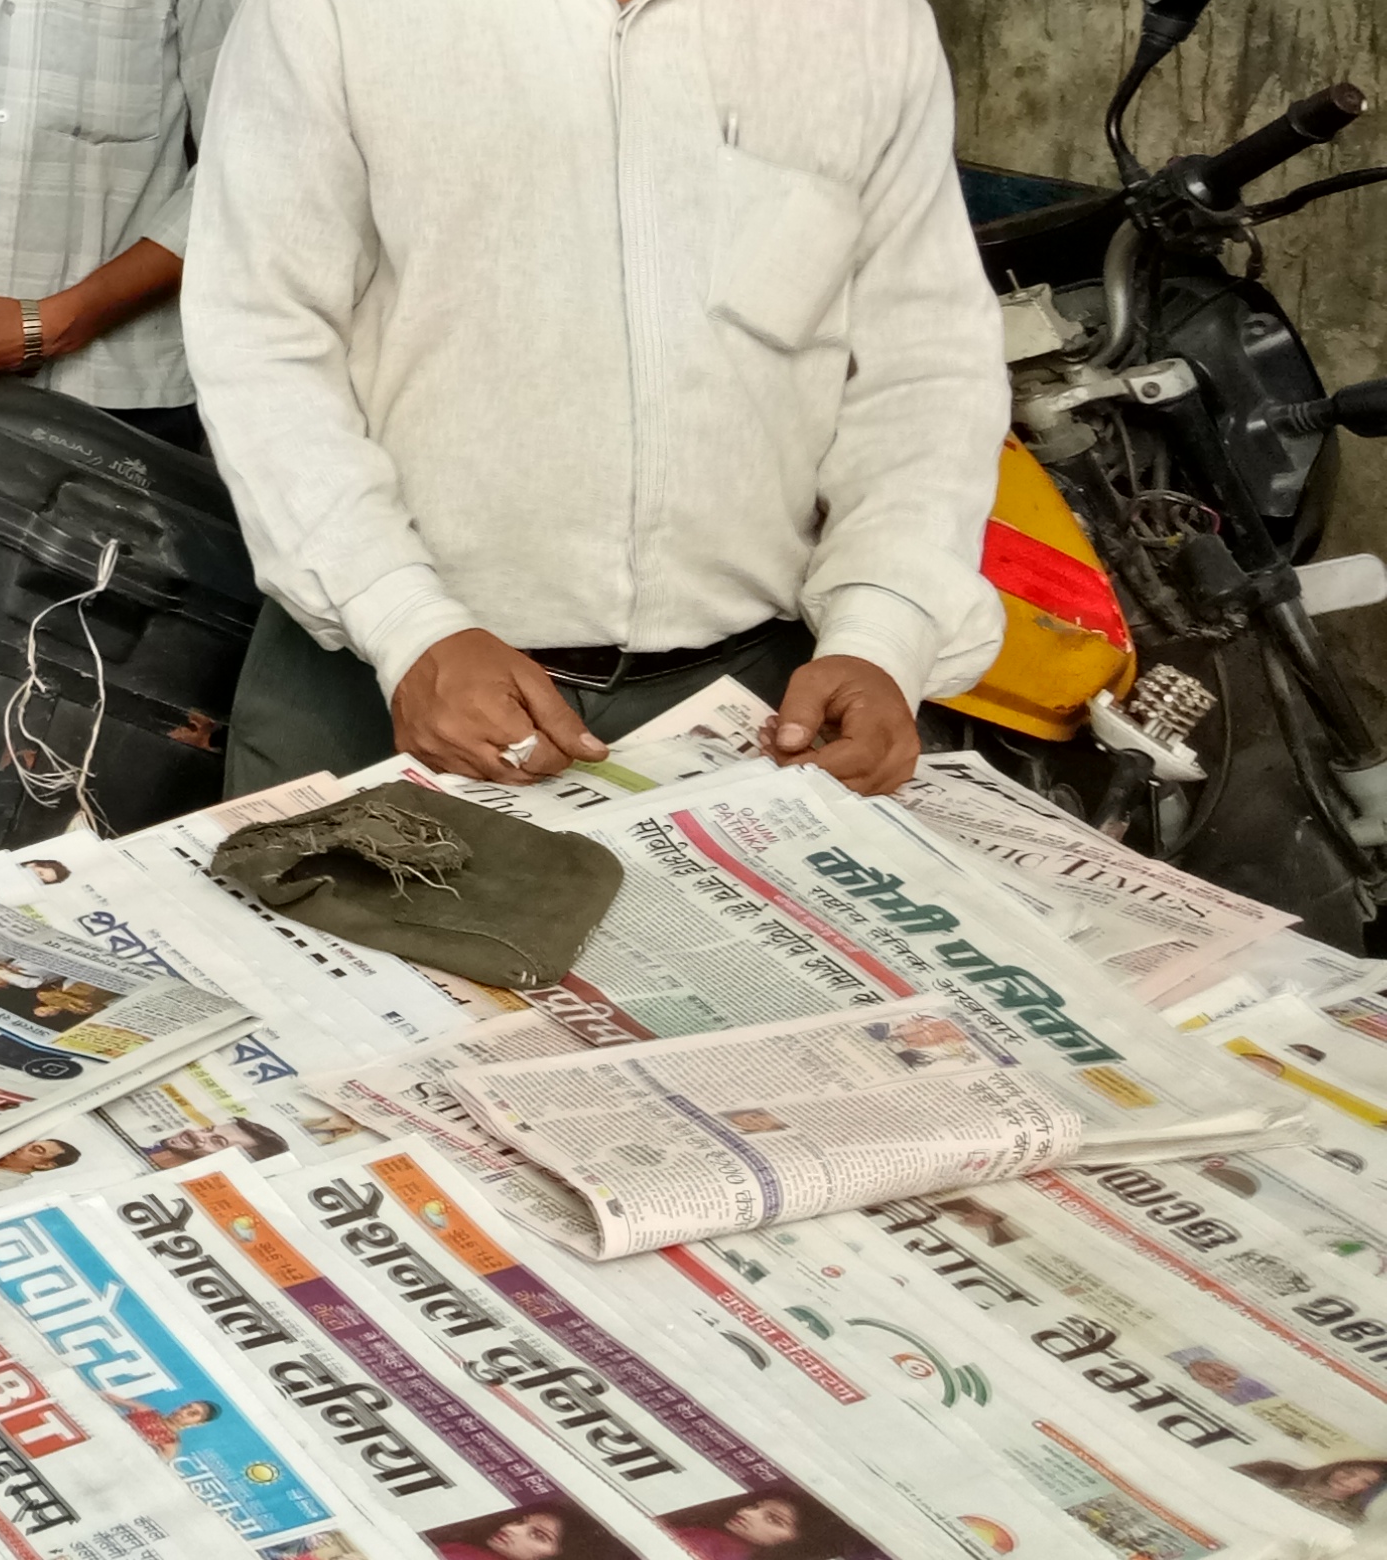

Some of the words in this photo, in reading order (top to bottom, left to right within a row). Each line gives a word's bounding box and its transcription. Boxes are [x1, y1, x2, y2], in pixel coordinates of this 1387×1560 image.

[708, 802, 769, 856] PATRIKA
[739, 807, 780, 845] QAUMI
[1054, 853, 1212, 919] TIMES
[803, 846, 961, 934] कौमी
[932, 938, 1126, 1065] पत्रिका
[932, 976, 1027, 1047] अखबार
[117, 1192, 300, 1353] नेशनल
[308, 1177, 508, 1338] नेशनल
[463, 1340, 688, 1482] दुनिया
[715, 1287, 778, 1340] राष्ट्रीय
[774, 1331, 863, 1403] संस्करण
[1030, 1312, 1258, 1450] वैभव
